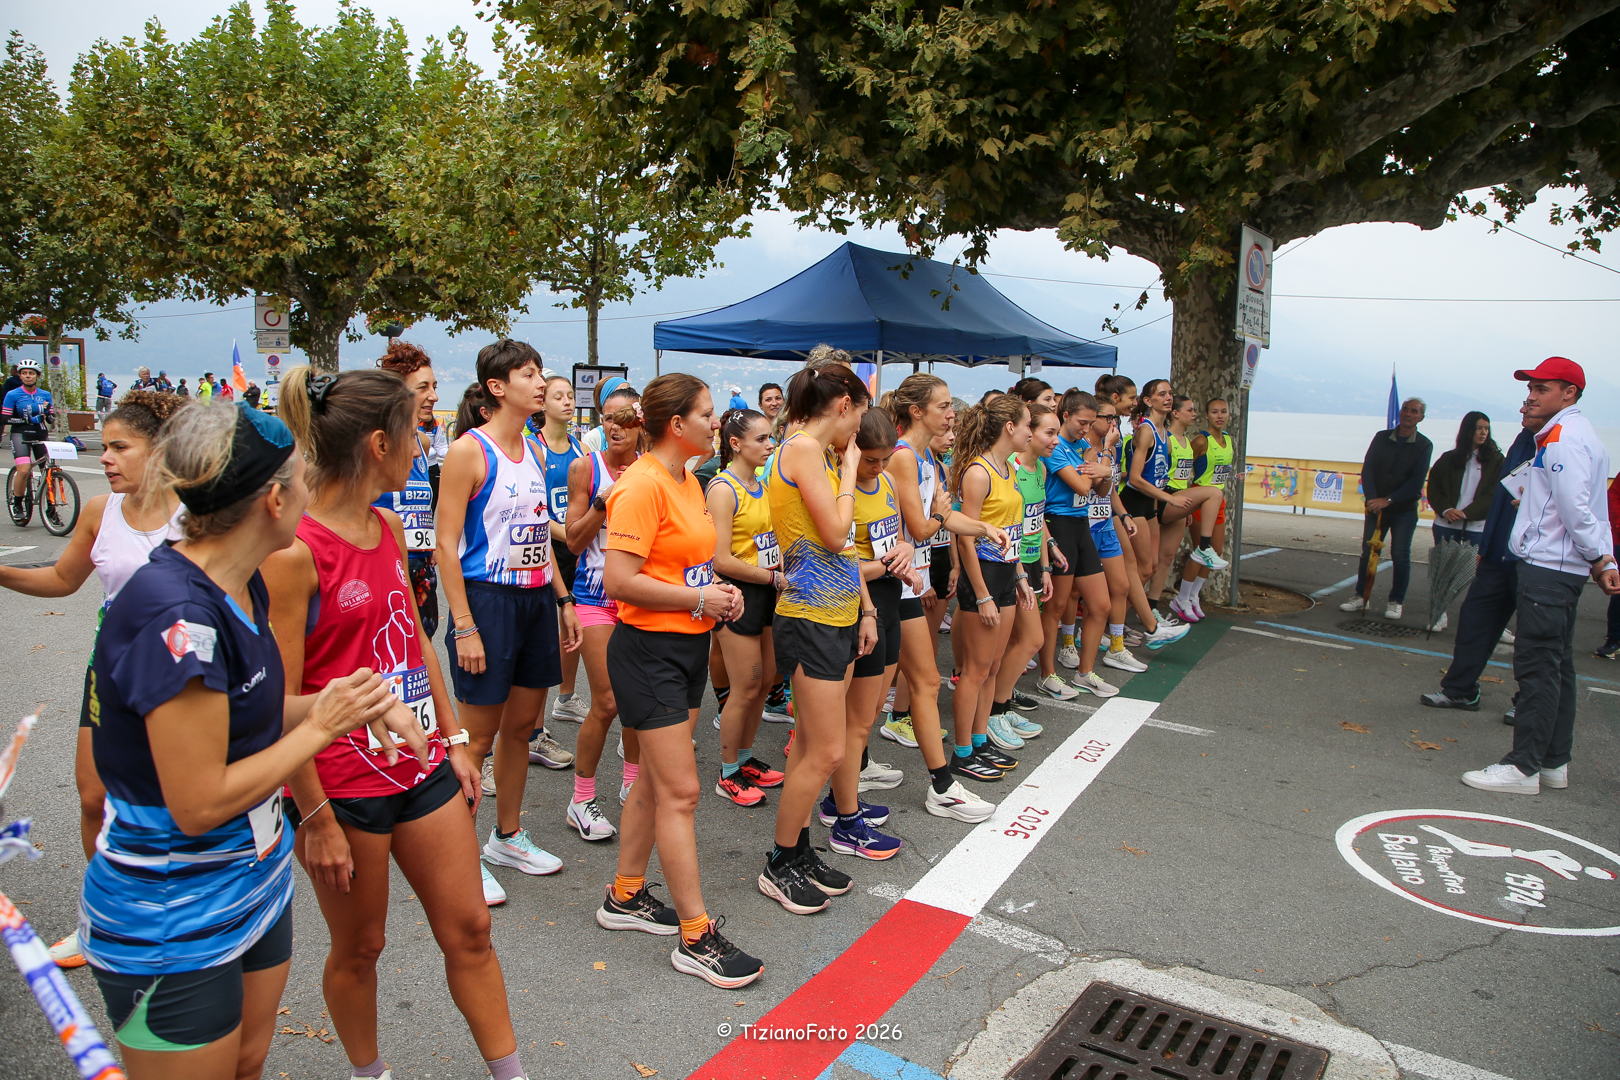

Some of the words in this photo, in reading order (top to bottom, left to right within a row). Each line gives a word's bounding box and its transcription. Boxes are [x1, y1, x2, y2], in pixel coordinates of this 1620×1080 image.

[405, 490, 431, 500] BIZZI
[1092, 506, 1110, 517] 385
[414, 530, 431, 547] 96
[521, 544, 547, 566] 558
[1073, 739, 1111, 763] 2022
[1004, 806, 1050, 839] 2026
[1377, 832, 1426, 885] Bellano
[1504, 872, 1547, 908] 1974
